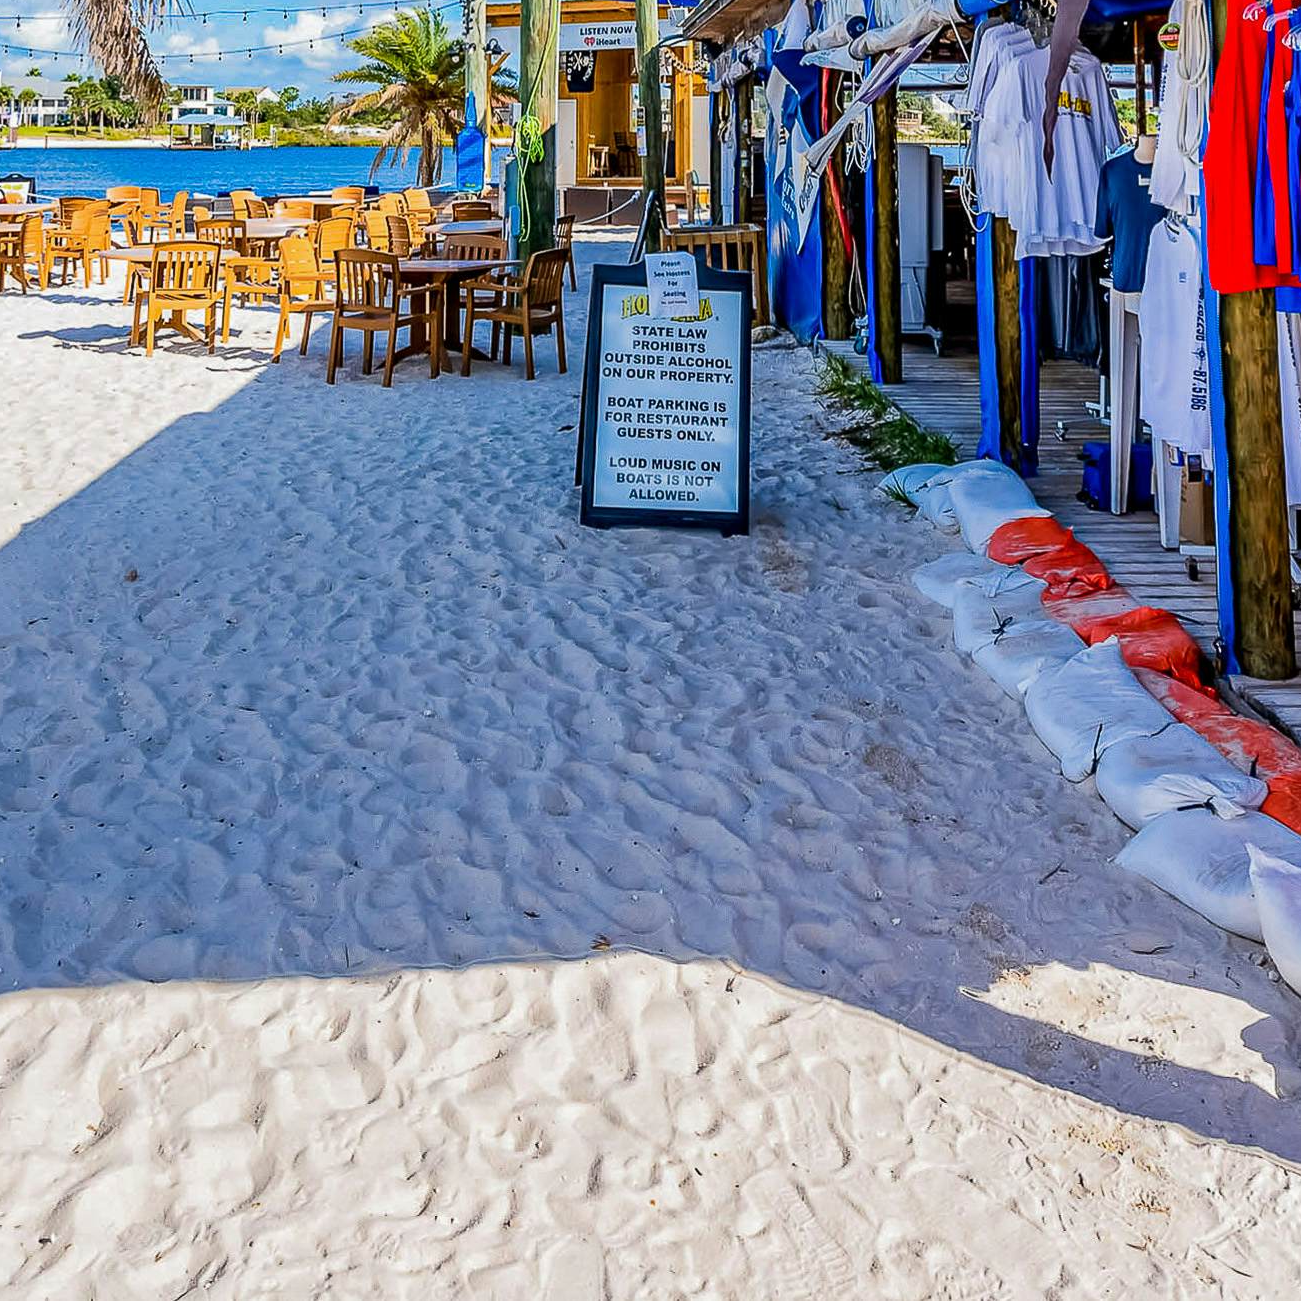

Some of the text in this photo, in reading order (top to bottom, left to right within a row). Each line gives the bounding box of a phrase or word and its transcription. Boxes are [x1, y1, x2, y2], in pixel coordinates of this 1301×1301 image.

[580, 25, 633, 36] LISTEN NOW
[632, 325, 707, 339] STATE LAW
[632, 340, 706, 353] PROHIBITS
[604, 353, 733, 369] OUTSIDE ALCOHOL
[602, 367, 734, 384] ON OUR PROPERTY.
[607, 397, 727, 412] BOAT PARKING IS
[605, 411, 728, 427] FOR RESTAURANT
[617, 427, 715, 442] GUESTS ONLY.
[609, 457, 721, 472] LOUD MUSIC ON
[616, 472, 714, 487] BOATS IS NOT
[629, 489, 699, 501] ALLOWED.
